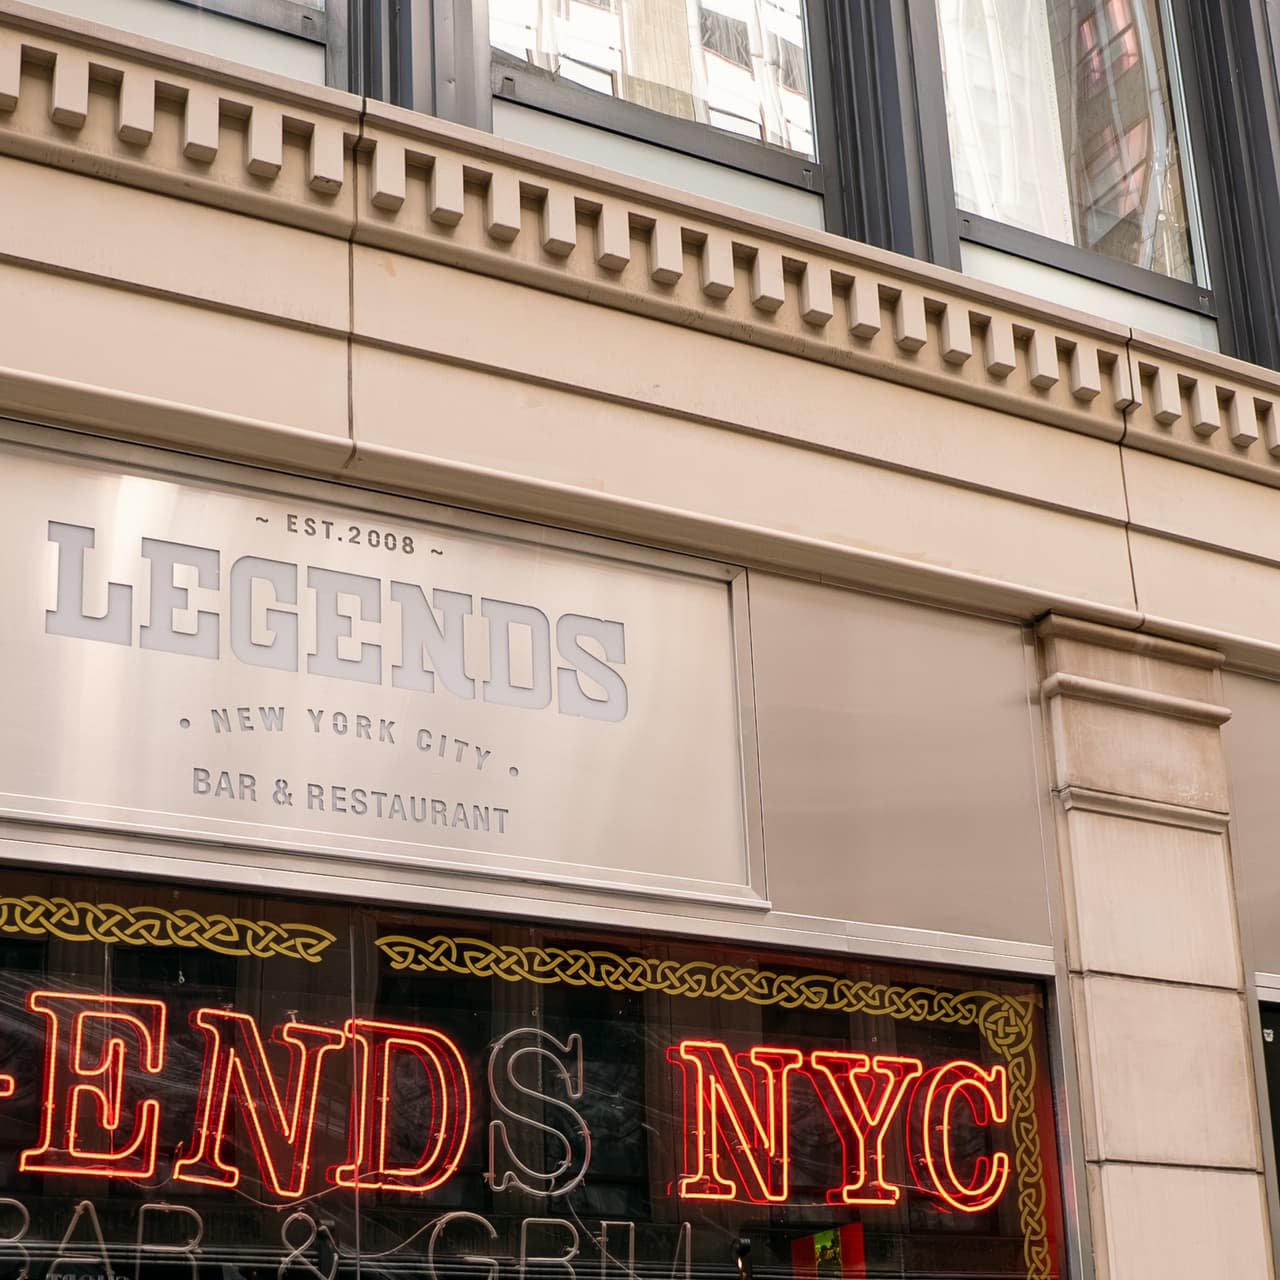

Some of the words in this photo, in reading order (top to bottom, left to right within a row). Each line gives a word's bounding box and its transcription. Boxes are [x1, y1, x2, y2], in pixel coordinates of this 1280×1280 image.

[45, 519, 629, 723] LEGENDS
[211, 706, 286, 737] NEW
[307, 708, 397, 746] YORK
[416, 727, 493, 772] CITY
[192, 767, 259, 805] BAR
[272, 776, 294, 806] &
[307, 782, 510, 835] RESTAURANT
[667, 1039, 1013, 1214] NYC
